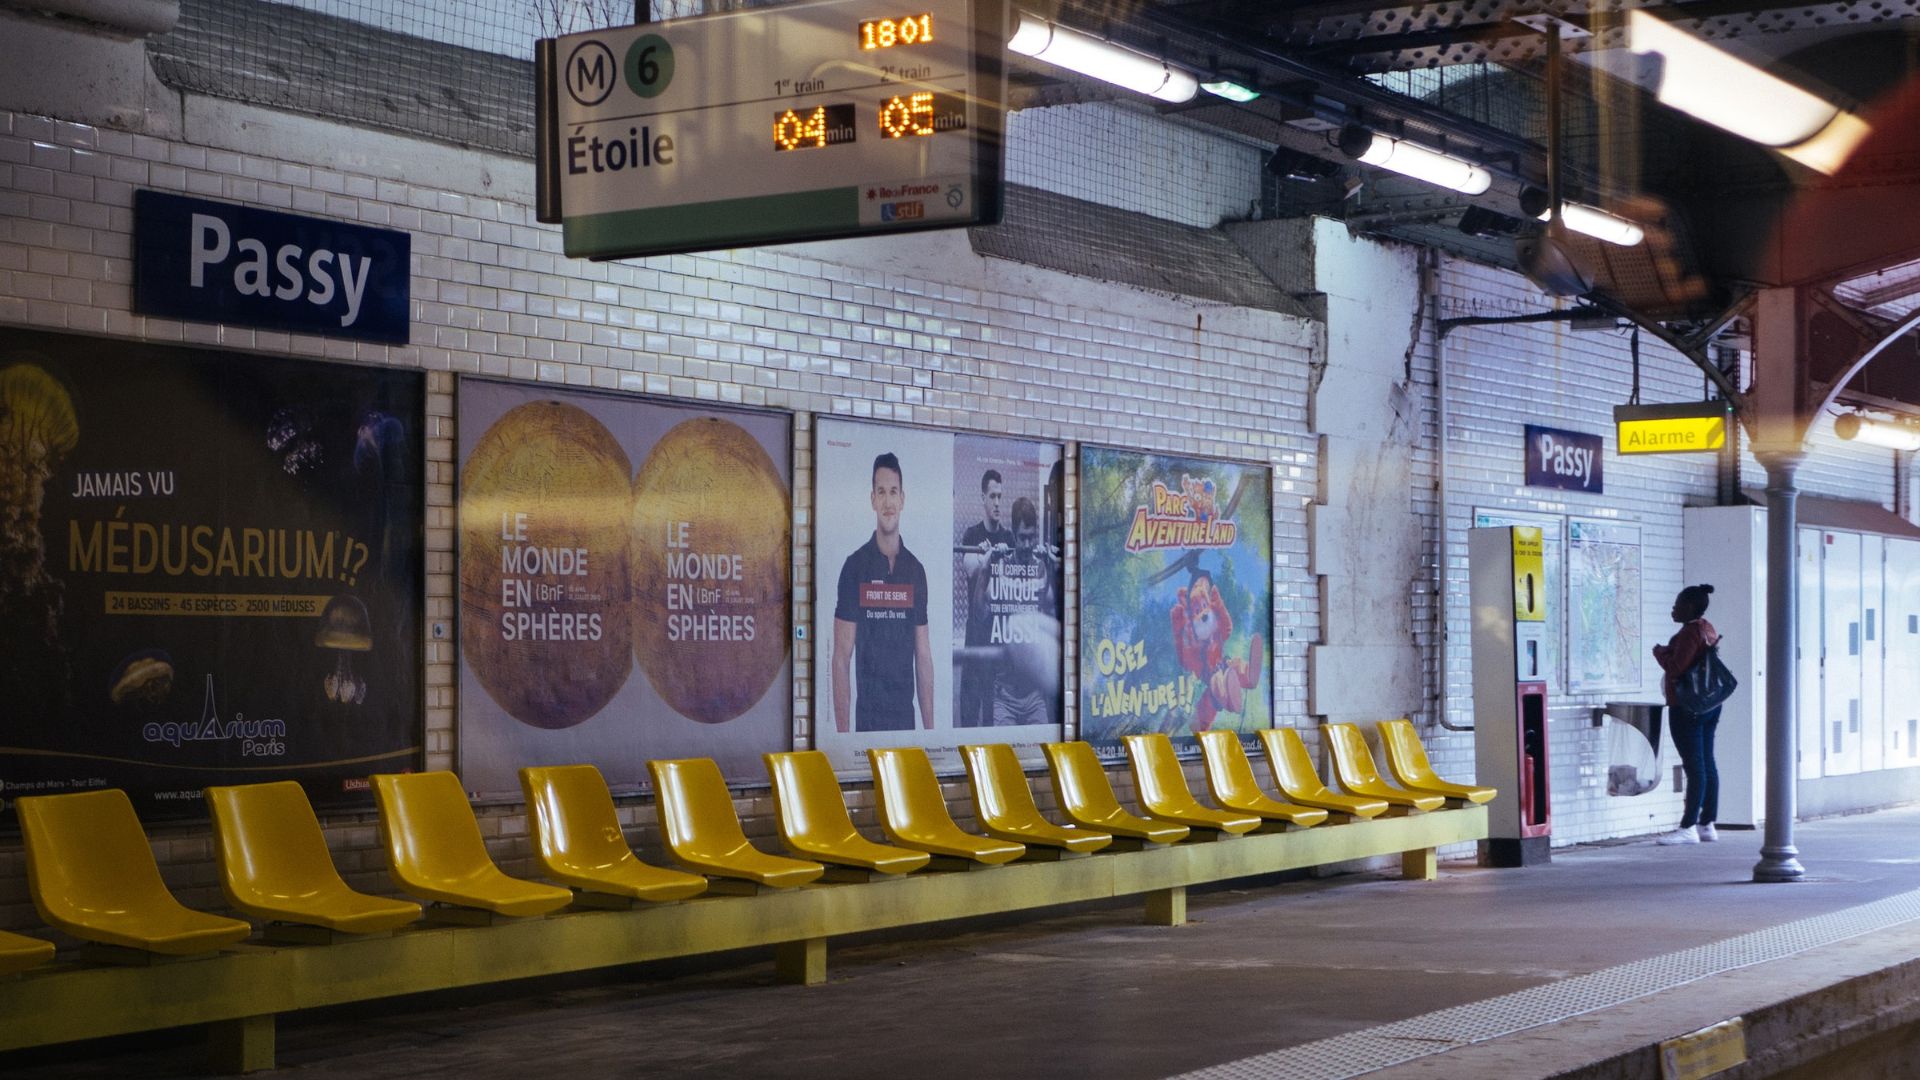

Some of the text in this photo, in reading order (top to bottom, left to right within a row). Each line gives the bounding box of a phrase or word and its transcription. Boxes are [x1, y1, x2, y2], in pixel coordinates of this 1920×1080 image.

[638, 45, 660, 86] 6
[899, 64, 931, 80] train
[794, 78, 825, 94] train
[773, 107, 855, 151] 04 min
[879, 92, 965, 139] 05 min
[567, 126, 674, 176] Étoile
[190, 212, 372, 327] Passy
[1628, 430, 1696, 447] Alarme
[1540, 433, 1594, 488] Passy
[72, 471, 175, 498] JAMAIS VU
[1153, 484, 1188, 516] PARC
[502, 512, 528, 541] LE
[667, 521, 690, 549] LE
[1126, 508, 1236, 552] AVENTURELAND
[502, 546, 588, 576] MONDE
[667, 552, 743, 581] MONDE
[1004, 564, 1027, 577] CORPS
[1027, 565, 1039, 577] EST
[111, 596, 125, 610] 24
[127, 596, 171, 611] BASSINS
[180, 598, 193, 612] 45
[194, 595, 238, 613] ESPÈCES
[246, 599, 270, 613] 2500
[271, 595, 317, 613] MÉDUSES
[502, 579, 532, 608] EN
[667, 583, 694, 611] EN
[866, 590, 908, 601] FRONT DE SEINE
[990, 577, 1039, 602] UNIQUE
[502, 607, 603, 642] SPHÈRES
[667, 609, 756, 642] SPHÈRES
[866, 610, 874, 619] Du
[888, 610, 896, 619] Du
[990, 615, 1039, 645] AUSS
[1097, 639, 1147, 676] OSEZ
[242, 737, 286, 756] Paris
